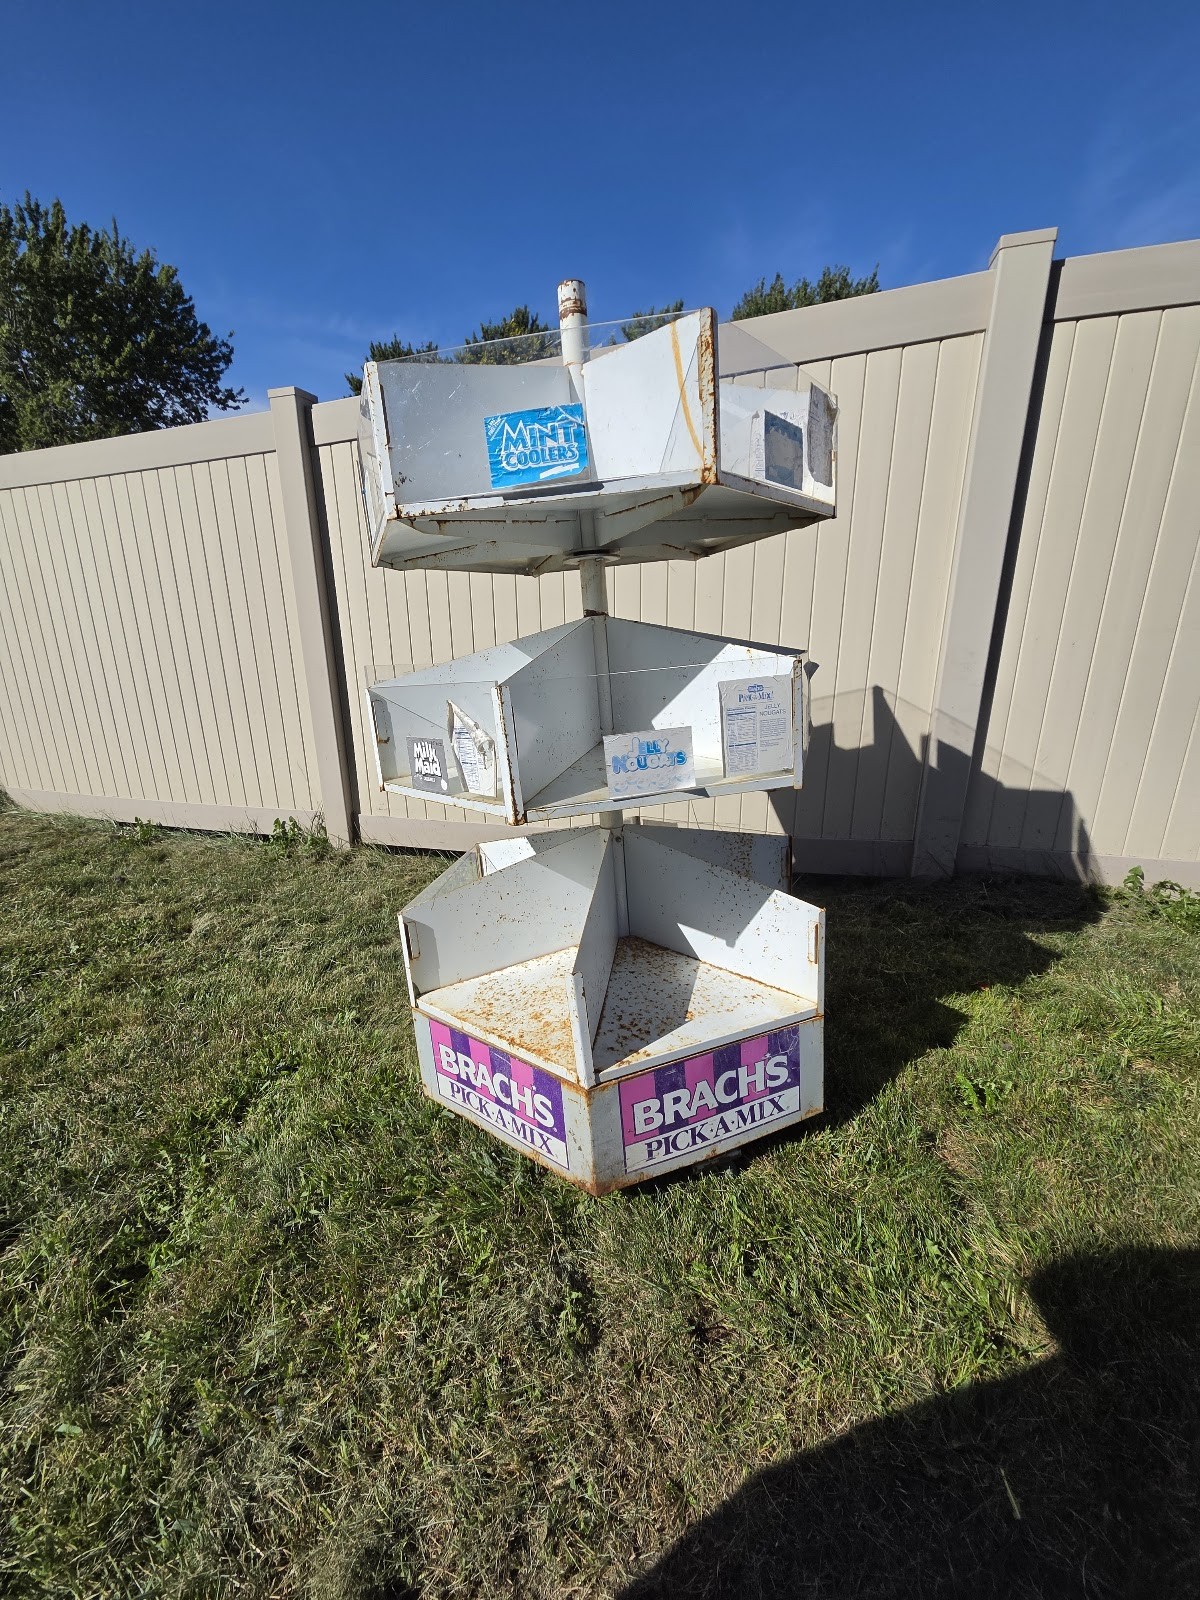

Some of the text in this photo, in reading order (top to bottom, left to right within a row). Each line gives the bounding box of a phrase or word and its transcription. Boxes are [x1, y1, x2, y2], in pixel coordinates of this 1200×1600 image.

[501, 419, 578, 451] MINT
[500, 443, 580, 471] COOLERS
[759, 708, 787, 717] NOUGATS
[764, 702, 781, 710] JELLY
[413, 741, 438, 763] Milk
[612, 750, 687, 775] NOUGATS
[414, 757, 442, 777] Maid
[438, 1042, 556, 1129] BRACH'S
[633, 1053, 790, 1135] BRACH'S
